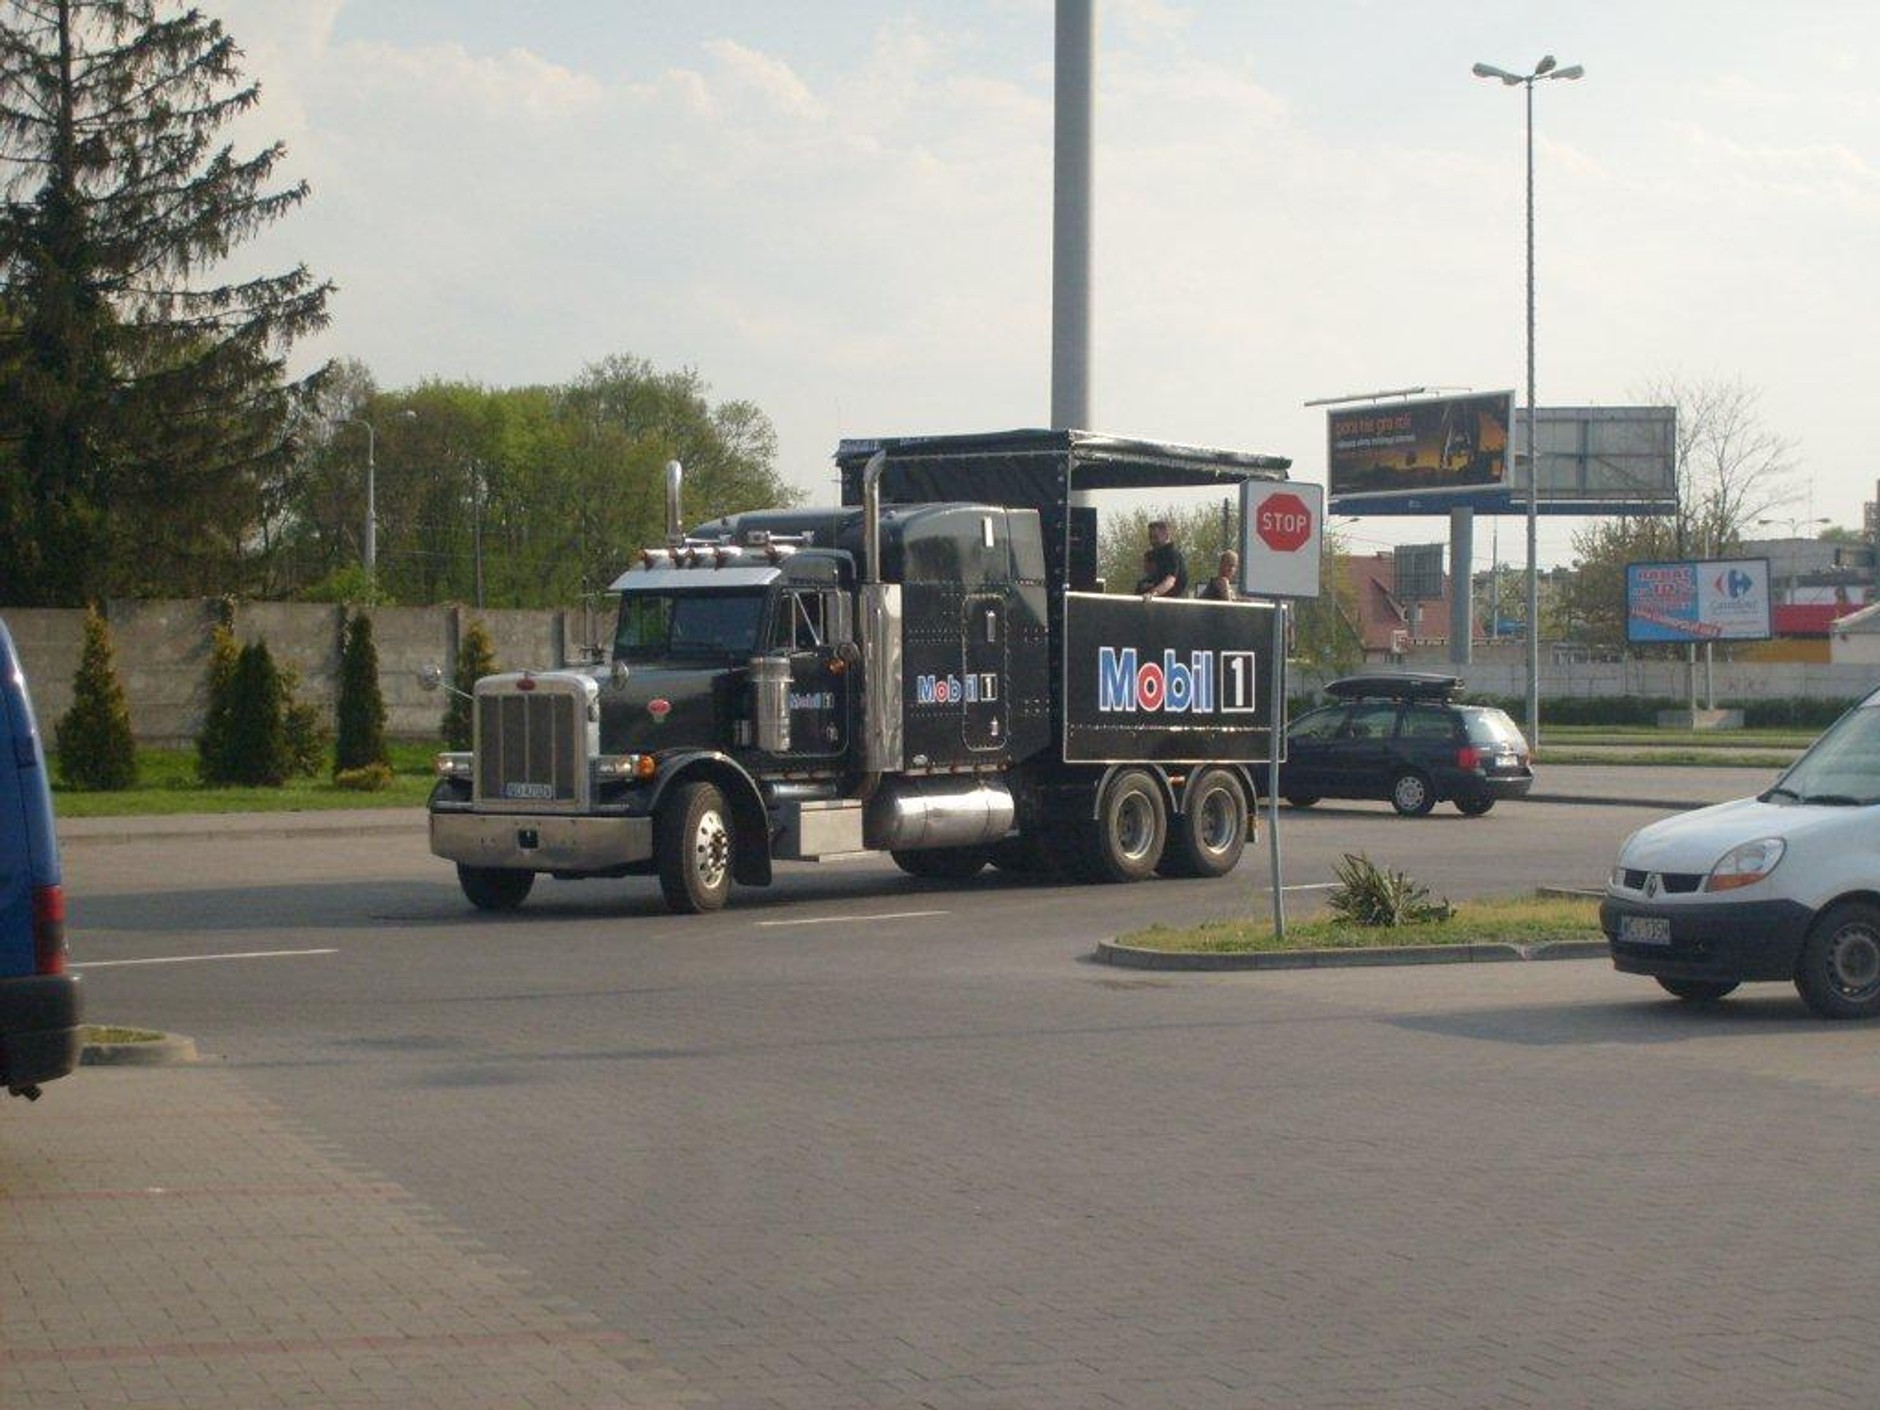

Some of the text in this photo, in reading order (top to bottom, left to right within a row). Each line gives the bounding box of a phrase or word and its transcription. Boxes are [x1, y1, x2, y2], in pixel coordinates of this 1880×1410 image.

[1262, 512, 1307, 532] STOP
[916, 674, 978, 703] Mobil
[1099, 646, 1213, 713] Mobil
